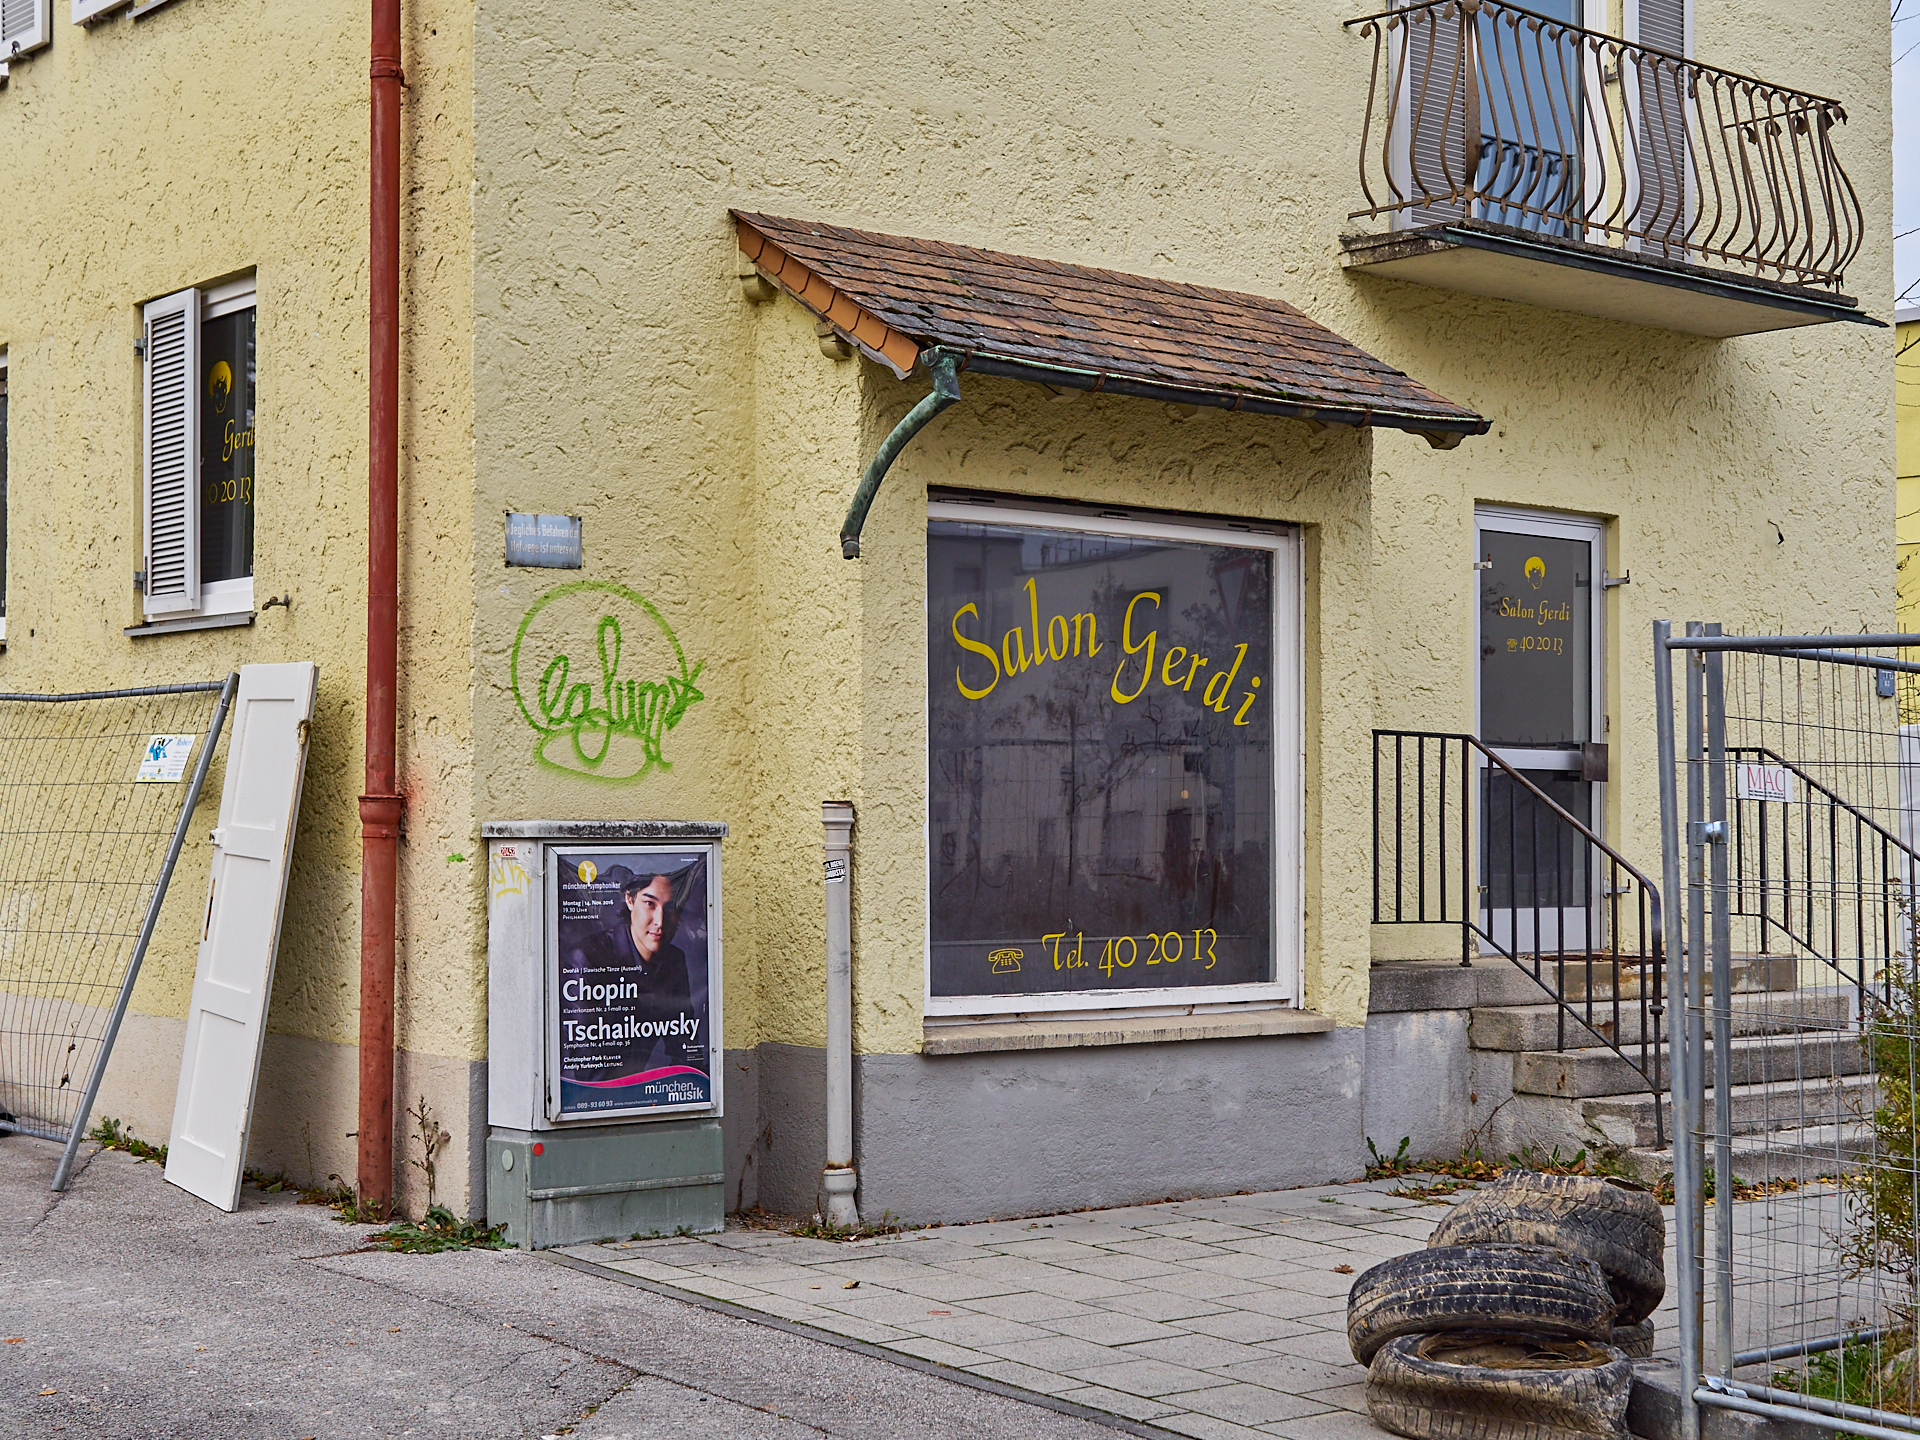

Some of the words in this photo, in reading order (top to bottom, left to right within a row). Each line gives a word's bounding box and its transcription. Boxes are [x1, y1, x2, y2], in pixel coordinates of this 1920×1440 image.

[221, 480, 236, 502] 20
[510, 523, 540, 538] Jegliches
[542, 524, 569, 538] Befahren
[570, 526, 579, 538] der
[510, 540, 539, 555] Hofwege
[540, 541, 549, 553] ist
[549, 543, 579, 557] untersagt
[1500, 597, 1534, 618] Salon
[1537, 600, 1570, 625] Gerdi
[952, 577, 1103, 700] Salon
[1111, 592, 1261, 726] Gerdi
[1519, 636, 1534, 652] 40
[1536, 636, 1551, 651] 20
[1553, 637, 1563, 655] 13
[1748, 766, 1785, 793] MAC
[1041, 931, 1088, 971] Tel.
[1098, 935, 1138, 978] 40
[1146, 931, 1183, 965] 20
[1191, 928, 1217, 970] 13
[620, 965, 643, 973] (Auswahl)
[562, 976, 638, 1006] Chopin
[562, 1012, 700, 1041] Tschaikowsky
[563, 1042, 590, 1050] Symphonie
[563, 1055, 591, 1063] Christopher
[580, 1061, 603, 1070] Yurkevych
[645, 1080, 695, 1095] münchen
[668, 1087, 704, 1102] musik
